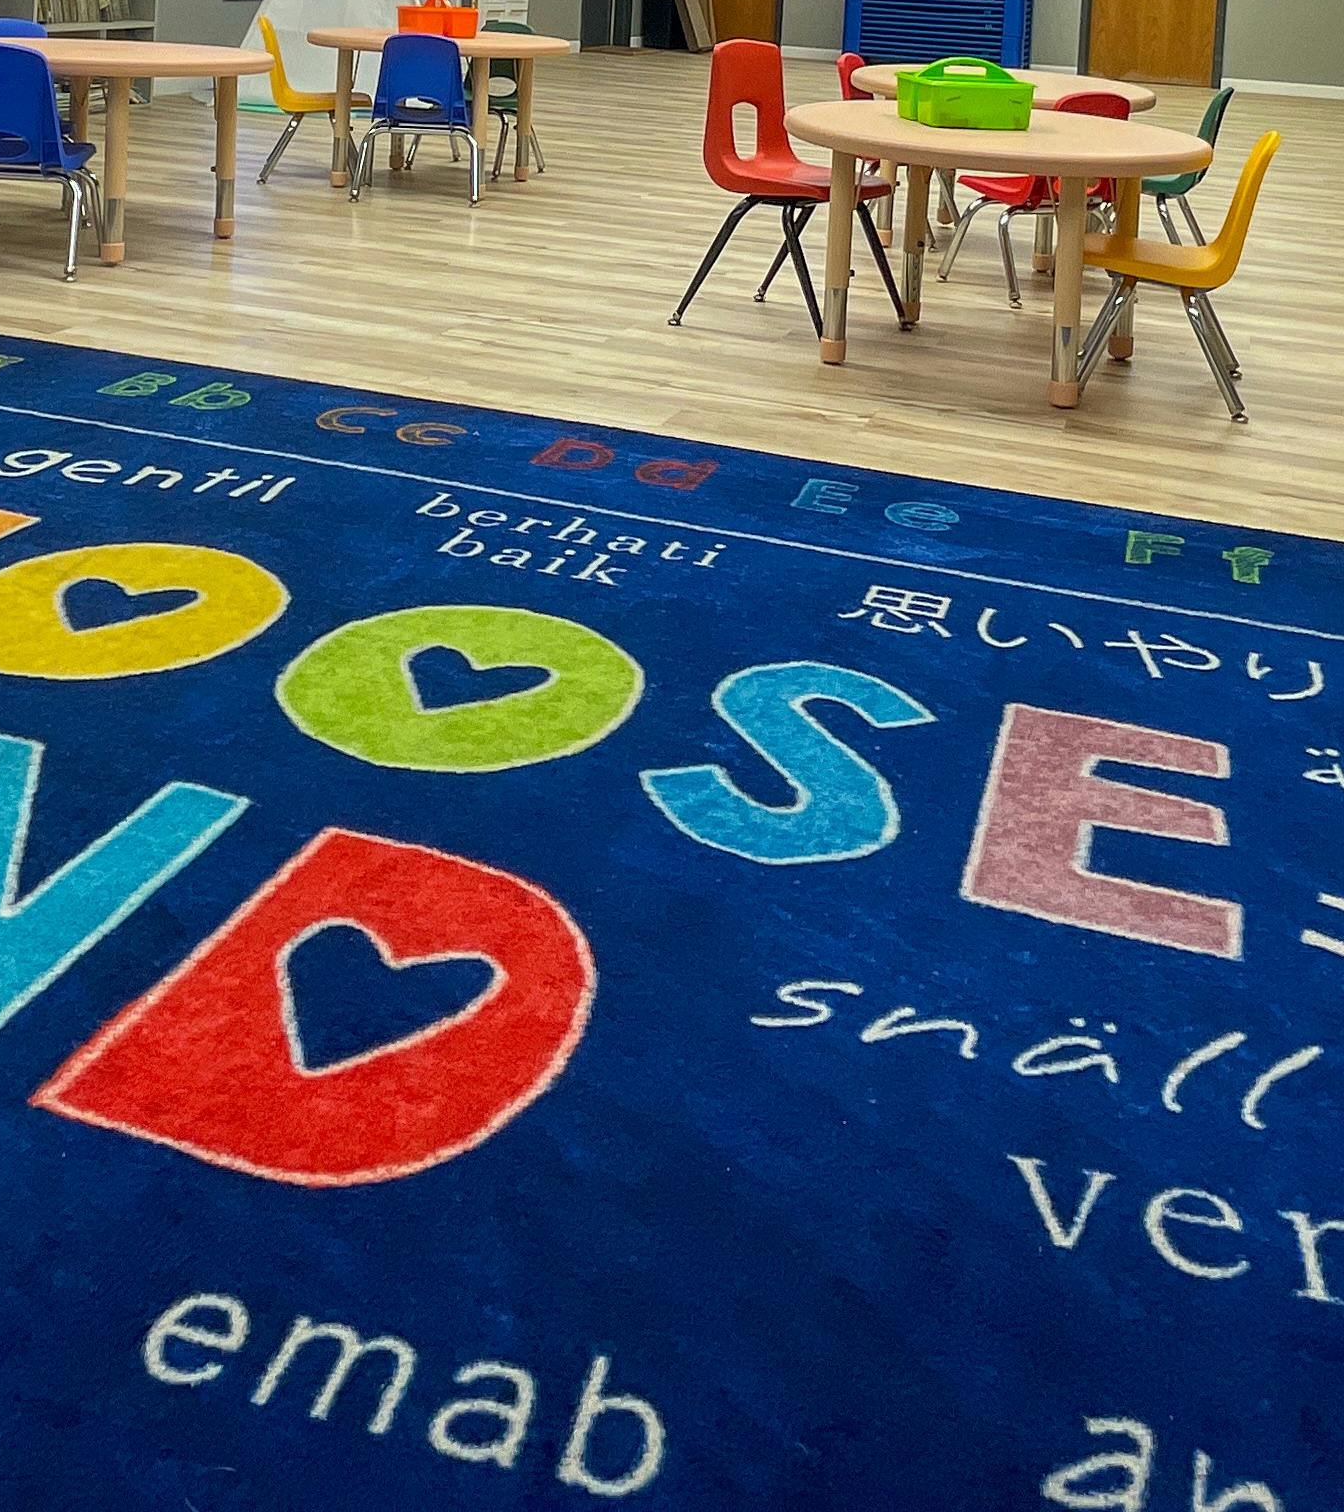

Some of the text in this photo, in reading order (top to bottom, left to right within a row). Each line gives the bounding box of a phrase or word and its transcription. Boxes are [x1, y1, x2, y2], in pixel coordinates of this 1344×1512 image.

[96, 370, 253, 411] Bb
[528, 437, 721, 492] Dd
[416, 492, 727, 574] berhati
[789, 477, 961, 532] Ee
[436, 527, 628, 586] baik
[1124, 528, 1277, 587] Ff
[837, 584, 1325, 701] 思いやり
[749, 979, 1324, 1130] snäll
[141, 1291, 667, 1498] emab
